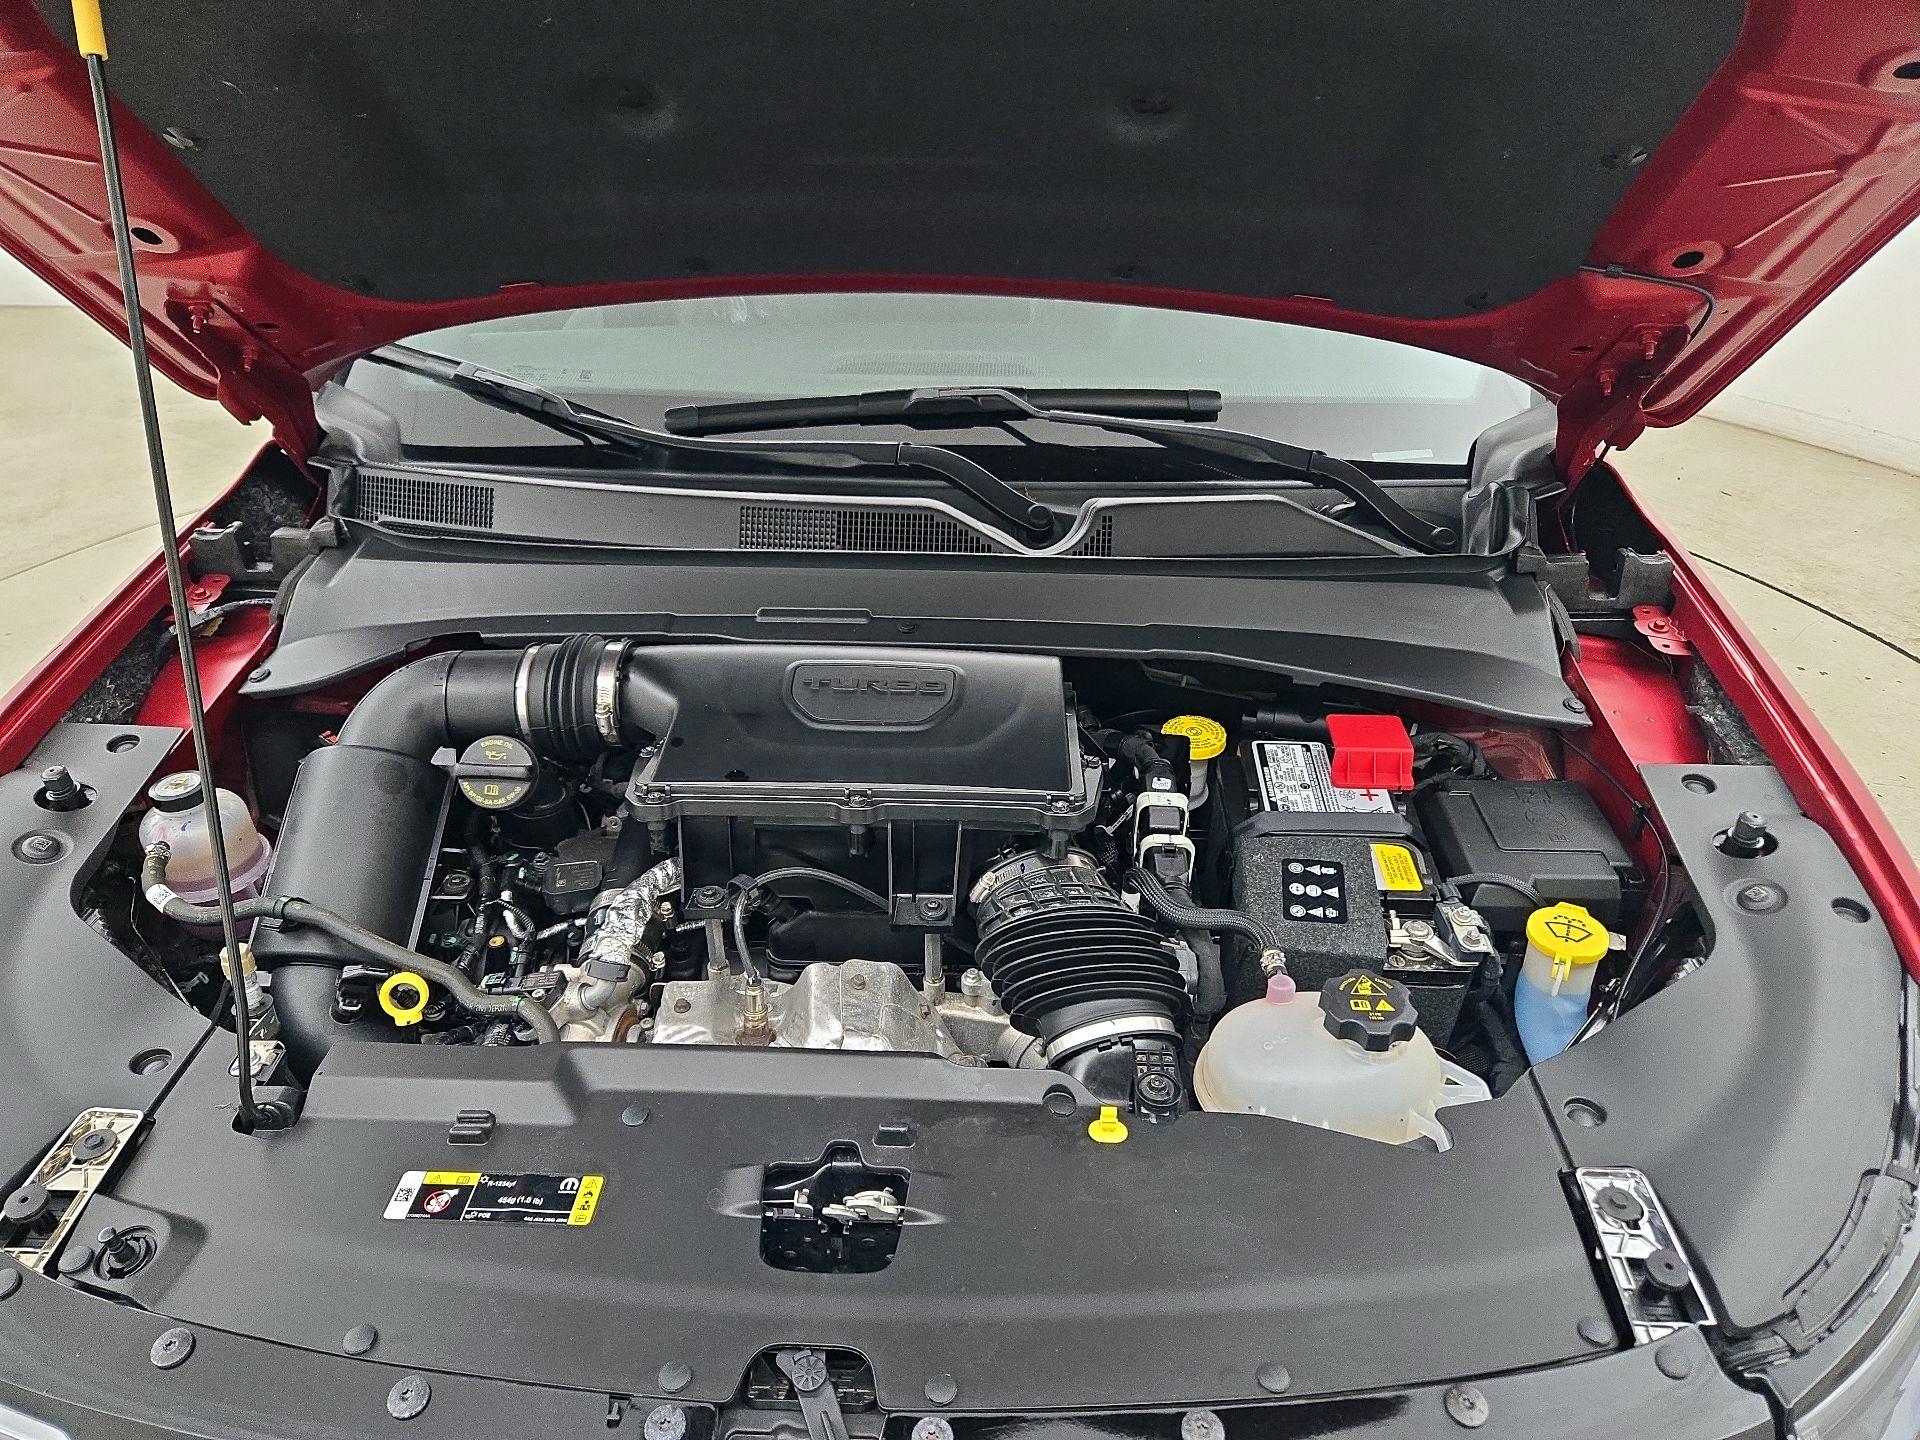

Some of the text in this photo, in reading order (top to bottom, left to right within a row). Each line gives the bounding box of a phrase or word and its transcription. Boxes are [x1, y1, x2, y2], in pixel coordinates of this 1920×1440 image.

[803, 677, 947, 695] TURBO
[480, 739, 513, 749] ENGINE OIL
